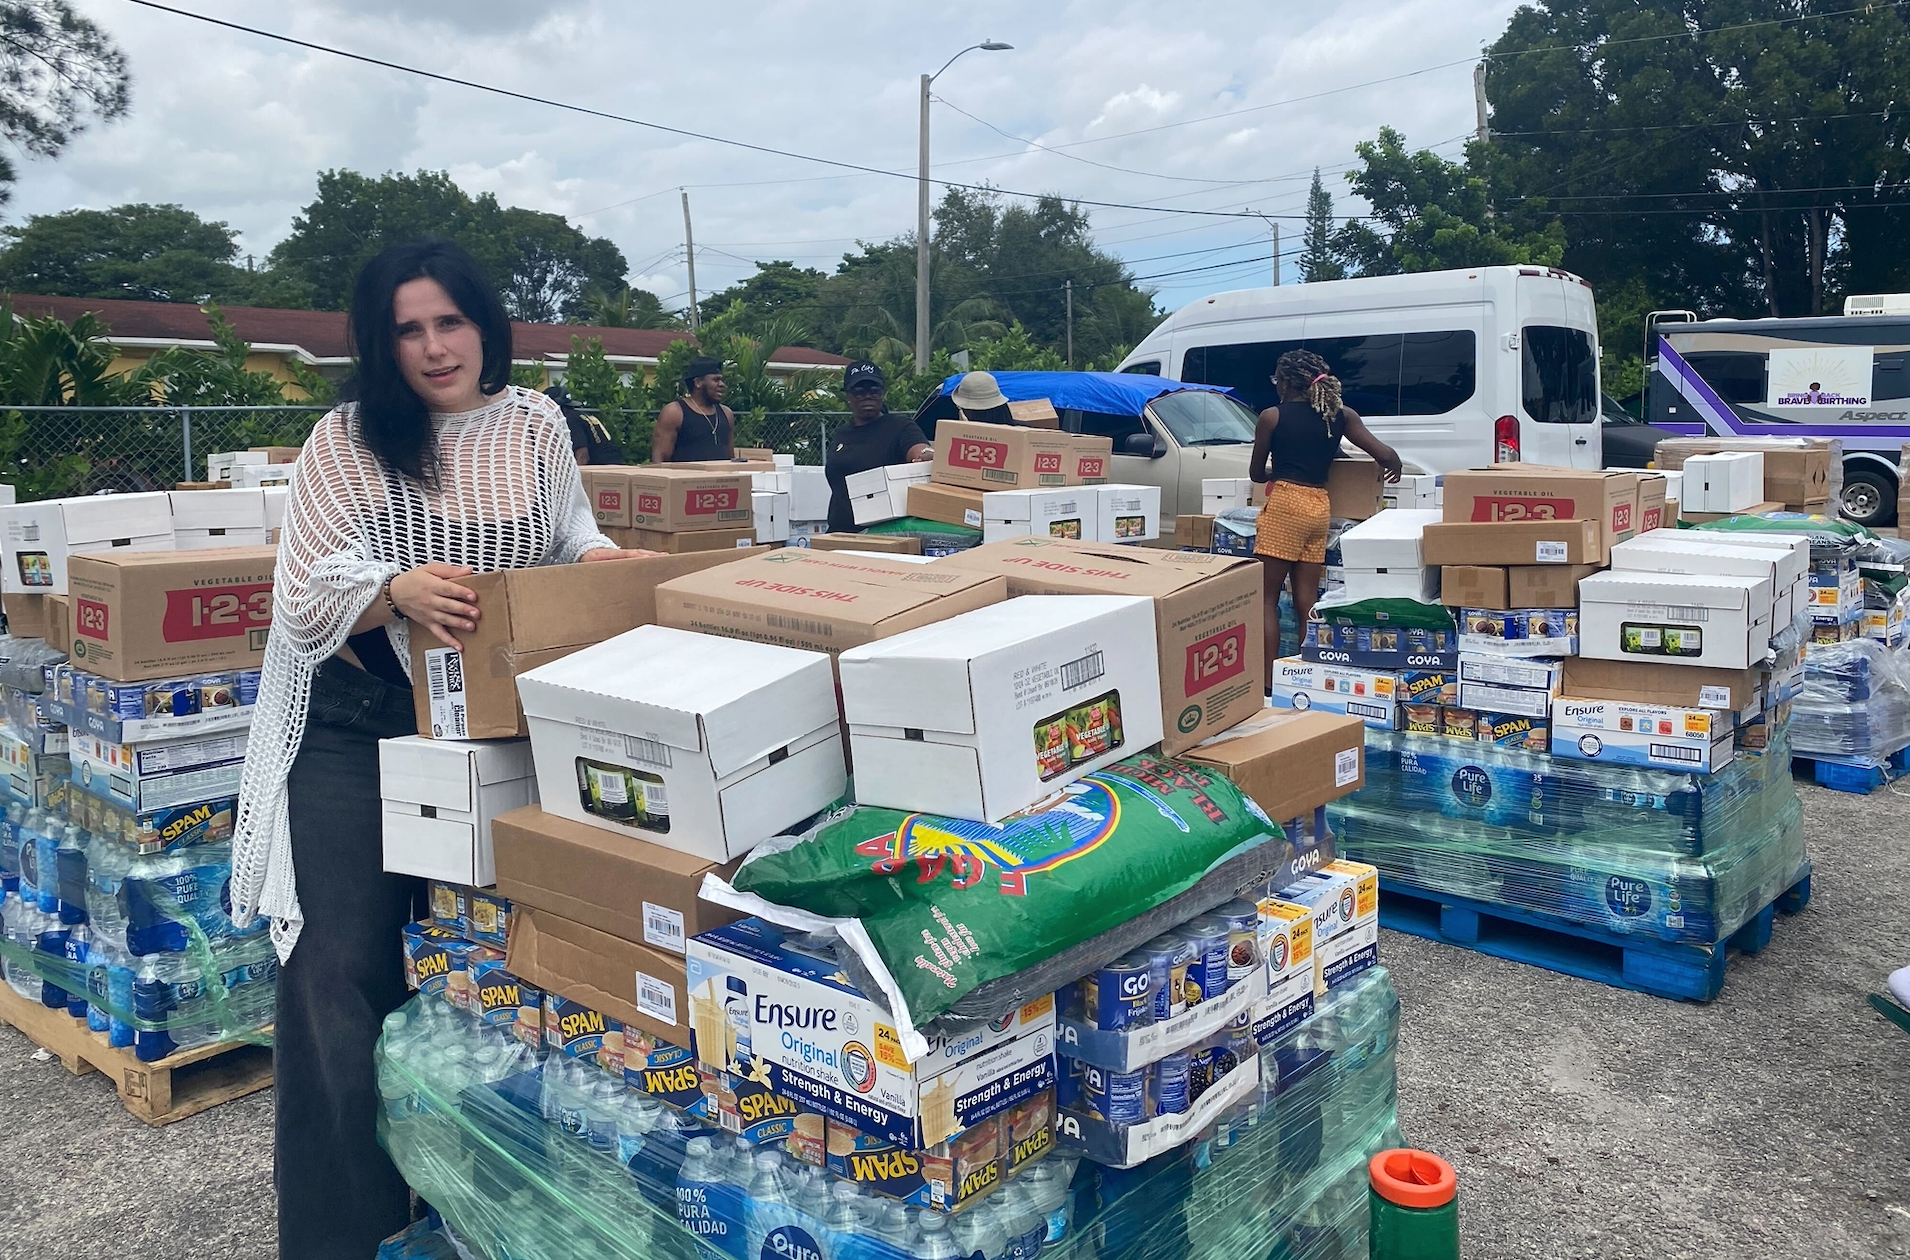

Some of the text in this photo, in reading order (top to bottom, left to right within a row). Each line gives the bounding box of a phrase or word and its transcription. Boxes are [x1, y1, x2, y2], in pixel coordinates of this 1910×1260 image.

[1839, 411, 1908, 422] Aspect
[1002, 556, 1131, 580] THIS SIDE UP
[193, 576, 252, 586] VEGETABLE
[736, 579, 859, 602] THIS SIDE UP
[1320, 650, 1350, 662] GOYA
[1407, 656, 1440, 666] GOYA
[1282, 667, 1313, 676] Ensure
[1410, 674, 1443, 694] SPAM
[1565, 705, 1604, 716] Ensure
[88, 716, 104, 732] GOYA
[454, 704, 462, 737] Cleaner
[1409, 722, 1435, 732] SPAM
[1494, 718, 1530, 737] SPAM
[1578, 716, 1604, 724] Original
[1446, 726, 1472, 737] SPAM
[1401, 758, 1418, 766] PURA
[1401, 765, 1428, 776] CALIDAD
[1460, 769, 1486, 784] Pure
[1533, 774, 1542, 782] 35
[1463, 781, 1482, 795] Life
[162, 804, 212, 842] SPAM
[177, 826, 204, 846] CLASSIC
[1291, 848, 1320, 876] GOYA
[174, 874, 198, 886] 100%
[1612, 878, 1644, 892] Pure
[1358, 884, 1366, 894] 24
[1614, 890, 1640, 905] Life
[1292, 928, 1300, 940] 24
[1318, 922, 1338, 938] Original
[416, 952, 449, 978] SPAM
[914, 954, 958, 988] Naturally
[1324, 959, 1348, 978] Strength
[1348, 957, 1353, 965] &
[1354, 948, 1373, 963] Energy
[480, 984, 520, 1008] SPAM
[492, 1011, 514, 1022] CLASSIC
[728, 1006, 749, 1017] Ensure
[755, 994, 838, 1032] Ensure
[1252, 997, 1310, 1034] Strength & Energy
[560, 1010, 604, 1038] SPAM
[878, 1028, 890, 1040] 24
[574, 1039, 598, 1052] CLASSIC
[781, 1031, 838, 1069] Original
[879, 1044, 894, 1054] SAVE
[944, 1032, 984, 1058] Original
[654, 1050, 682, 1064] CLASSIC
[879, 1050, 895, 1064] 15%
[976, 1054, 998, 1070] nutrition
[998, 1048, 1012, 1062] shake
[782, 1055, 840, 1086] nutrition shake
[976, 1068, 996, 1083] Vanilla
[645, 1065, 698, 1093] SPAM
[956, 1084, 1002, 1113] Strength
[1004, 1078, 1010, 1091] &
[1013, 1062, 1046, 1088] Energy
[782, 1068, 888, 1126] Strength & Energy
[880, 1088, 906, 1107] Vanilla
[740, 1092, 798, 1121] SPAM
[757, 1122, 787, 1138] CLASSIC
[1014, 1126, 1050, 1165] SPAM
[851, 1149, 919, 1181] SPAM
[958, 1160, 998, 1200] SPAM
[678, 1203, 710, 1218] PURA
[680, 1220, 728, 1236] CALIDAD
